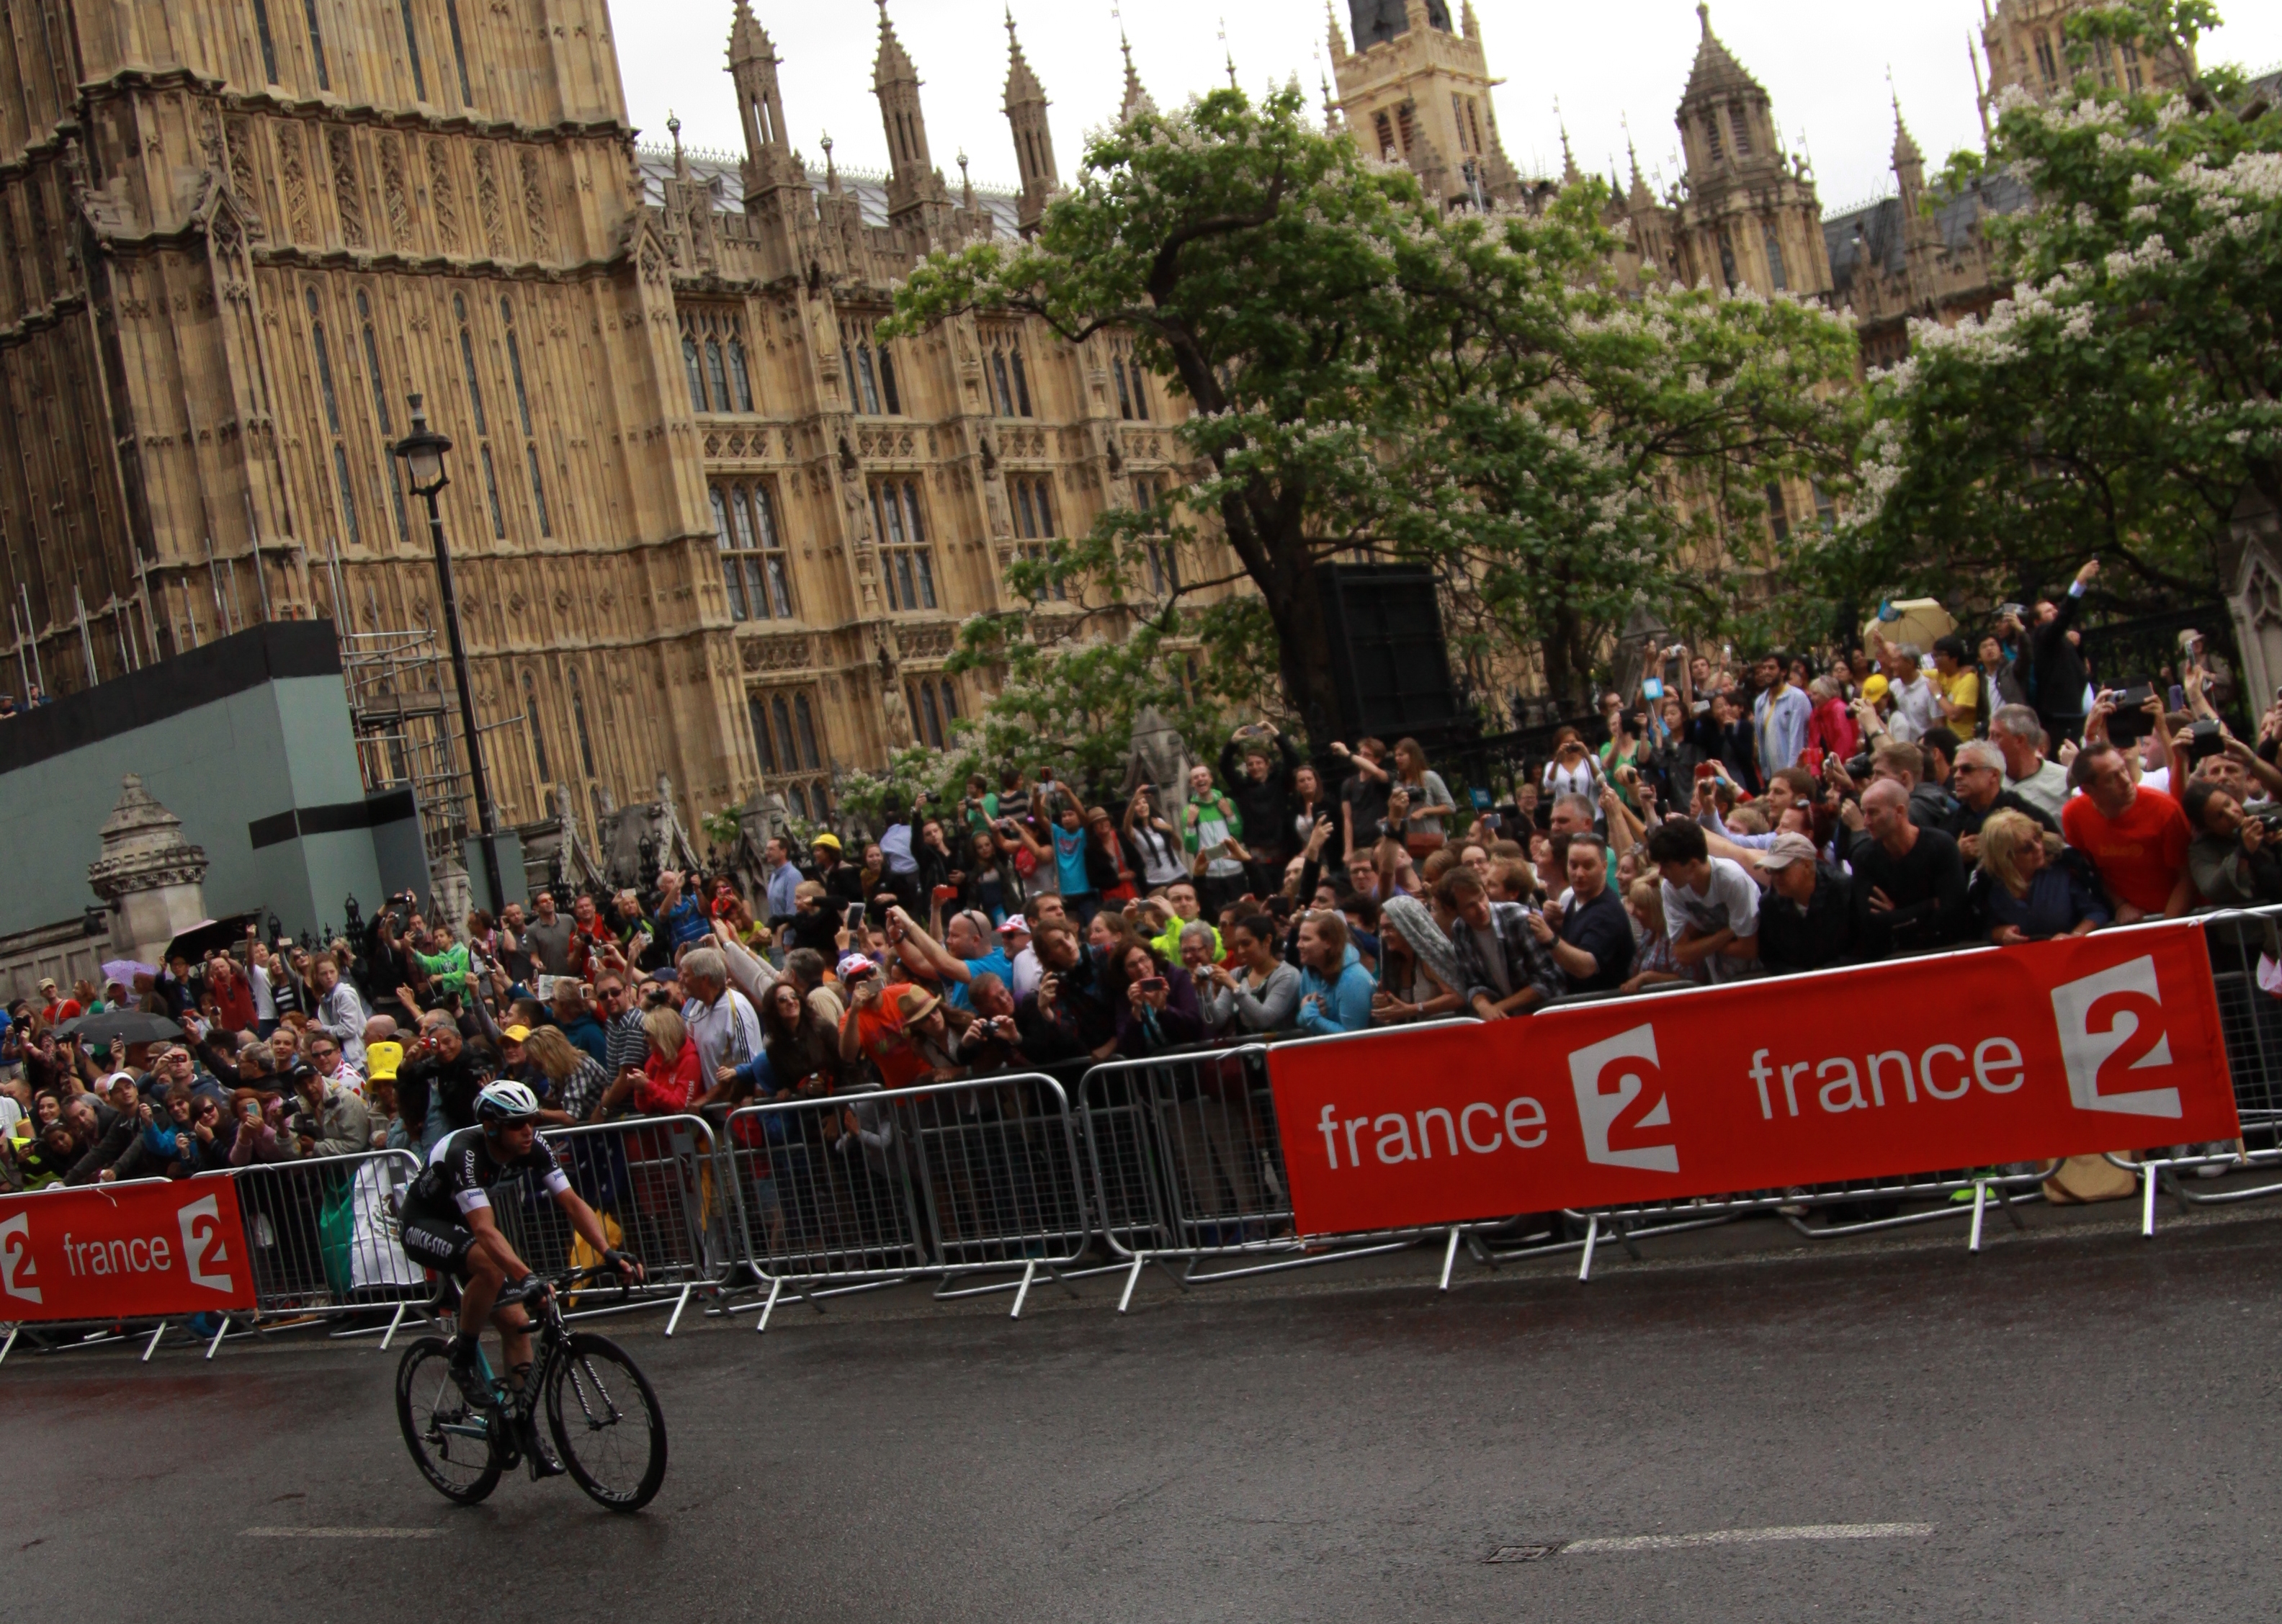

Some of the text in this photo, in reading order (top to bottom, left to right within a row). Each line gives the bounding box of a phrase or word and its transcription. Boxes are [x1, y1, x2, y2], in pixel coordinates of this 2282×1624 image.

[1748, 990, 2175, 1120] france 2
[1317, 1055, 1673, 1170] france 2
[465, 1149, 478, 1188] latexco
[63, 1232, 171, 1276] france
[192, 1213, 231, 1278] 2
